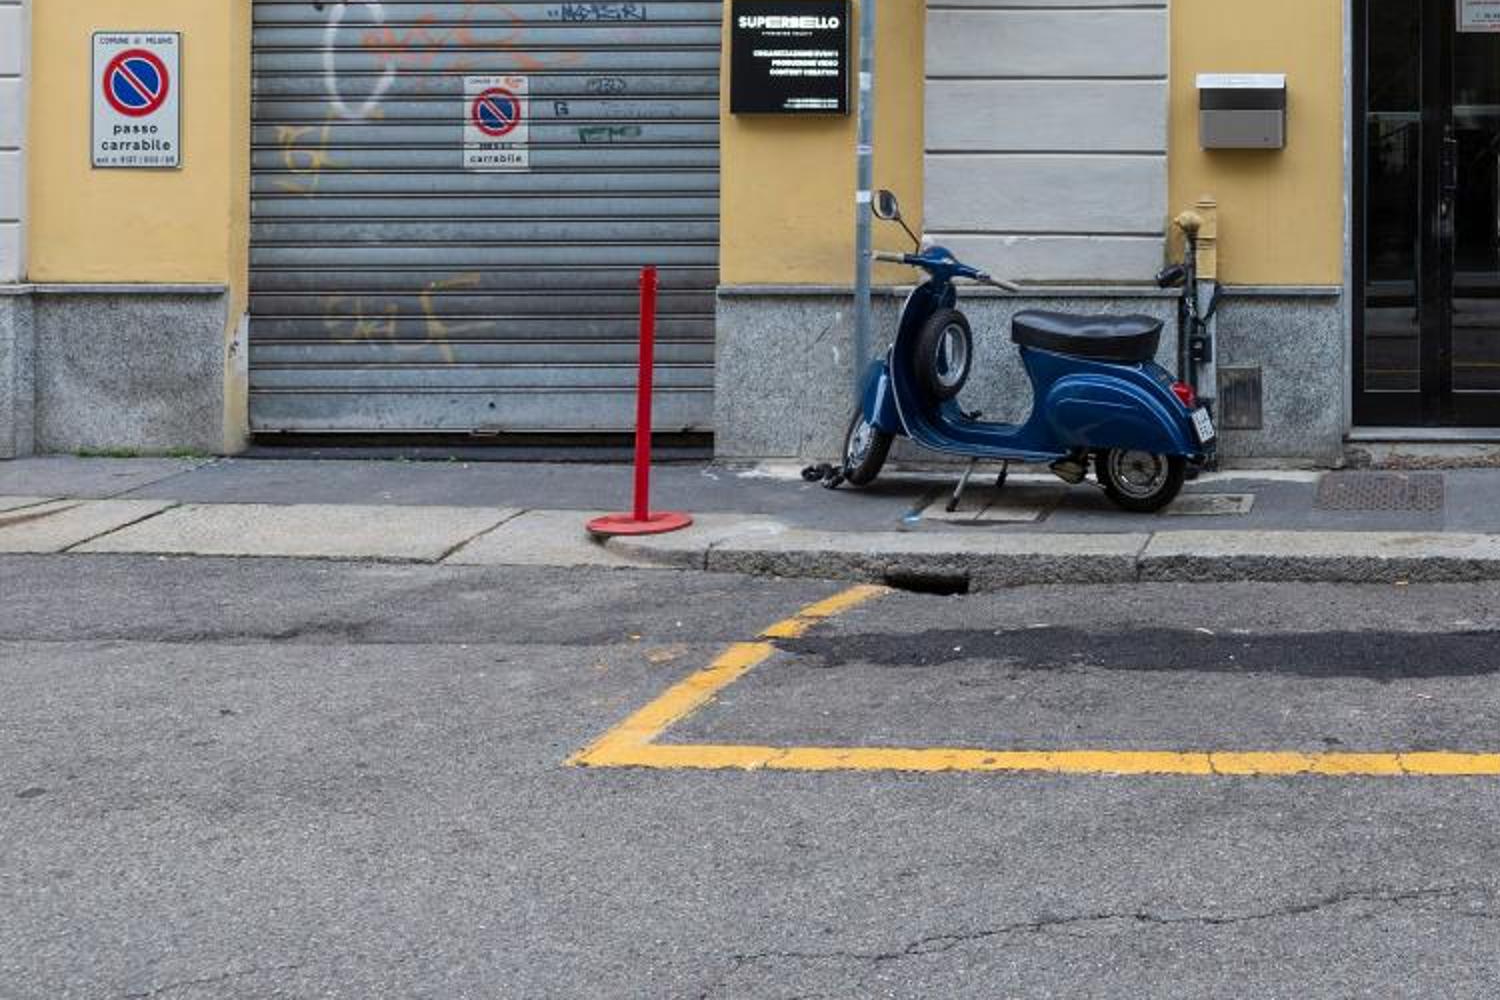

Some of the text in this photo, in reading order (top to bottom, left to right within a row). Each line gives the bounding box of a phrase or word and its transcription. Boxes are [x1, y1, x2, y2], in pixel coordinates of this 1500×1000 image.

[738, 15, 840, 29] SUPERBELLO
[113, 124, 159, 136] passo
[101, 139, 171, 151] carrabile
[470, 154, 522, 163] carrabile
